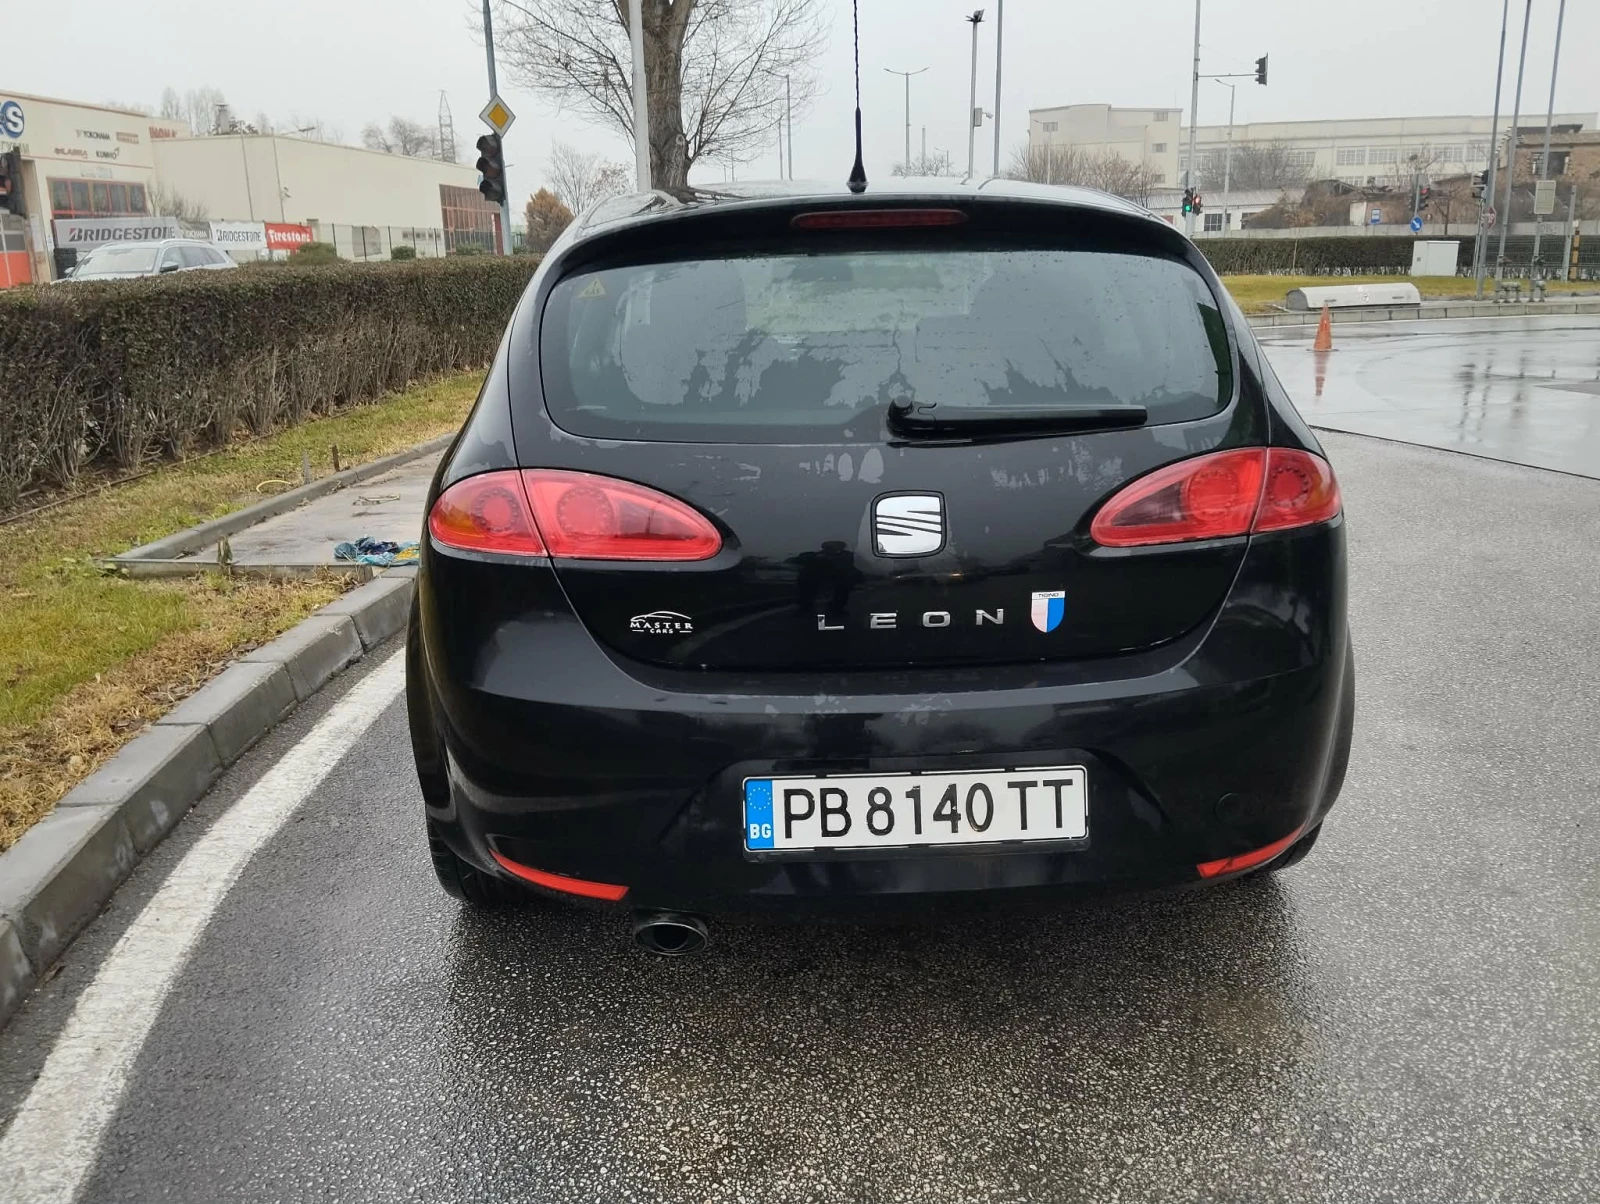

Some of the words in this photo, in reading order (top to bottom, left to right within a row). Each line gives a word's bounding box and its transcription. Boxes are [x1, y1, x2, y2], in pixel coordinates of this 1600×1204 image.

[817, 608, 1005, 631] LEON
[783, 788, 852, 838] PB
[866, 783, 994, 837] 8140
[1007, 779, 1073, 831] TT
[750, 823, 772, 839] BG
